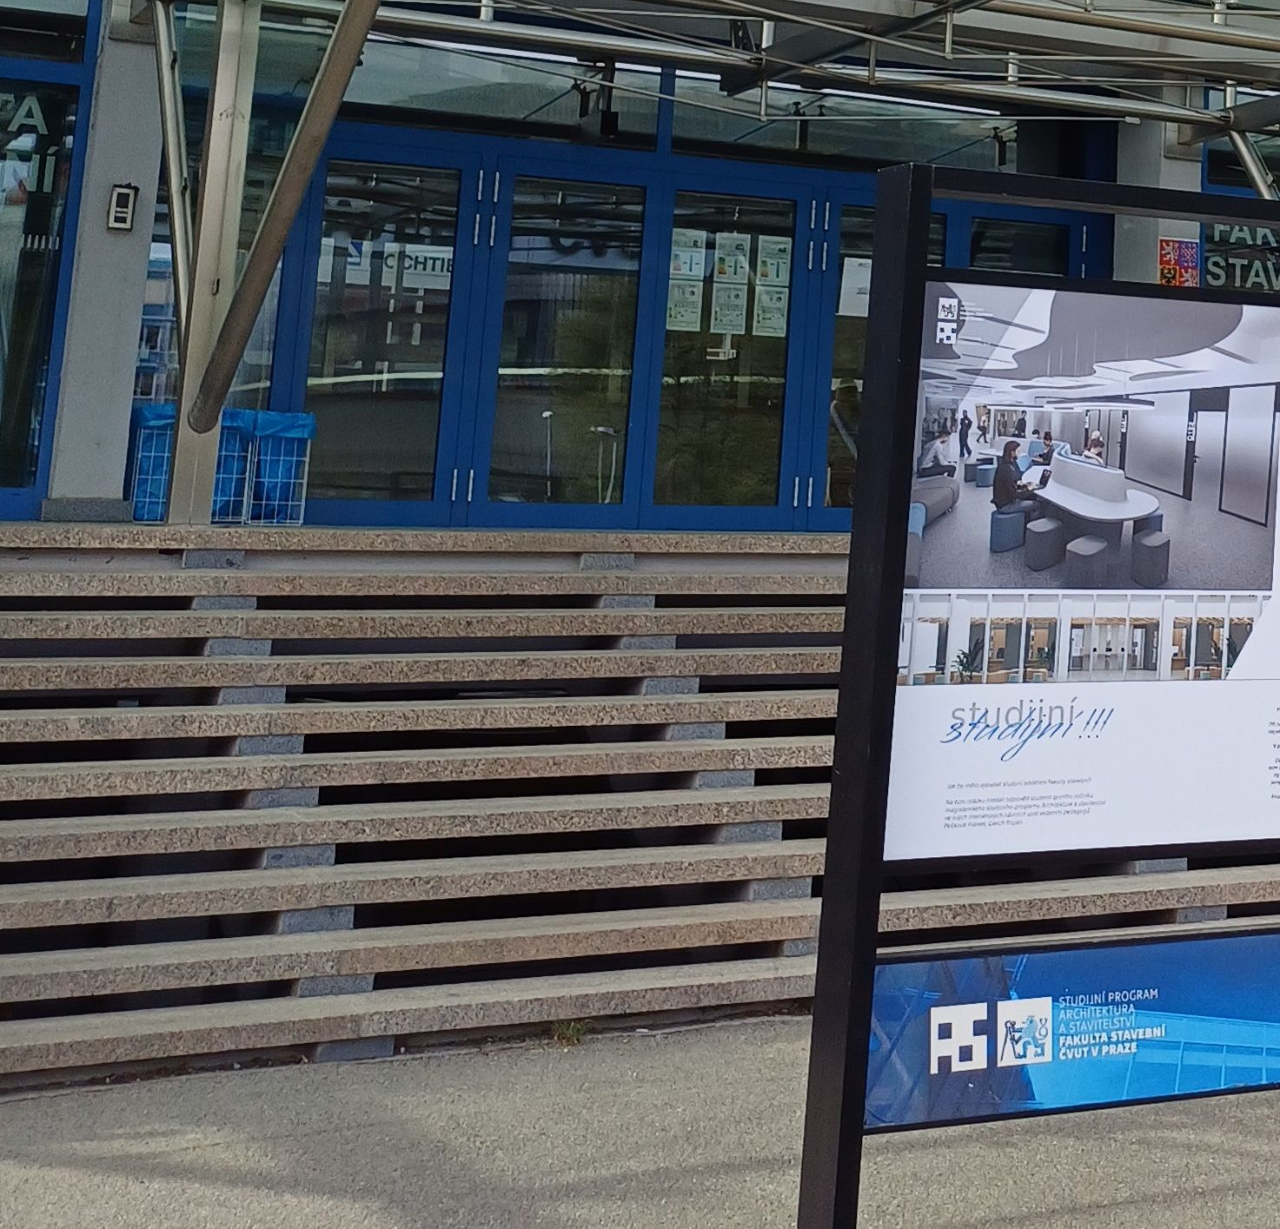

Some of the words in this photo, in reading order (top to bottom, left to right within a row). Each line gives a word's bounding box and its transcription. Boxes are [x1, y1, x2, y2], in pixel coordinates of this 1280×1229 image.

[1059, 991, 1106, 1008] STUDIJNÍ
[1108, 988, 1159, 1004] PROGRAM
[1059, 1004, 1136, 1021] ARCHITEKTURA
[1059, 1023, 1067, 1035] A
[1069, 1014, 1136, 1033] STAVITELSTVÍ
[1059, 1032, 1108, 1047] FAKULTA
[1111, 1023, 1166, 1043] STAVEBNÍ
[1059, 1046, 1089, 1061] ČVUT
[1091, 1046, 1099, 1057] V
[1101, 1042, 1138, 1056] PRAZE
